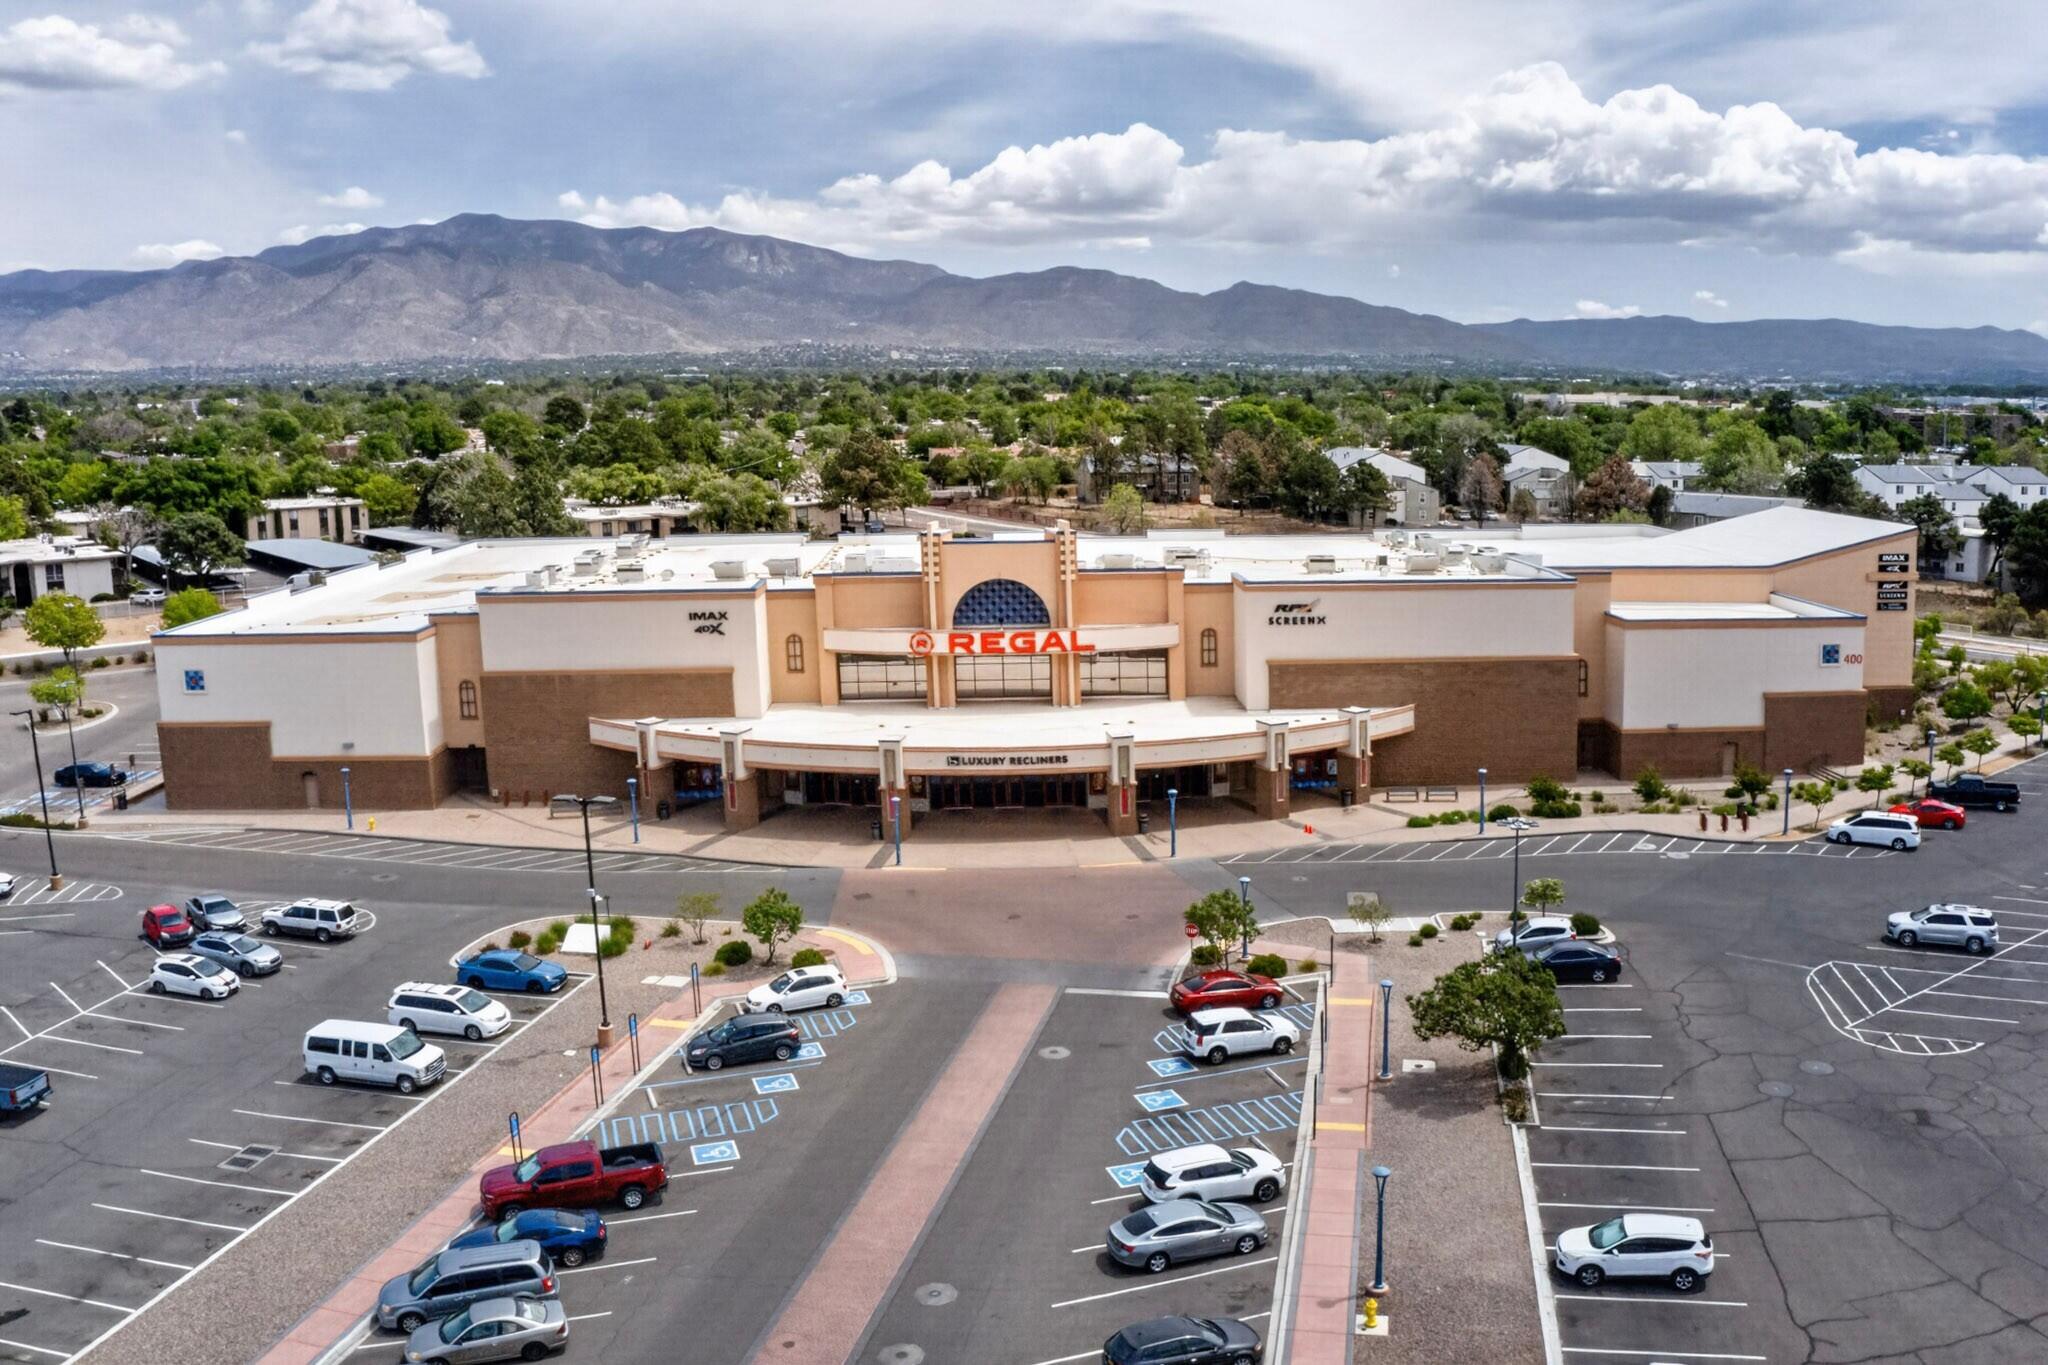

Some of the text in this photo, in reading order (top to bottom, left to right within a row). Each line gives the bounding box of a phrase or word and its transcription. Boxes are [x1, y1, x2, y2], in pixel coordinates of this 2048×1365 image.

[688, 611, 728, 621] IMAX
[1268, 616, 1326, 625] SCREENX
[694, 622, 725, 636] 4DX
[948, 631, 1096, 654] REGAL
[1843, 654, 1863, 664] 400
[962, 755, 1068, 765] LUXURY RECLINERS
